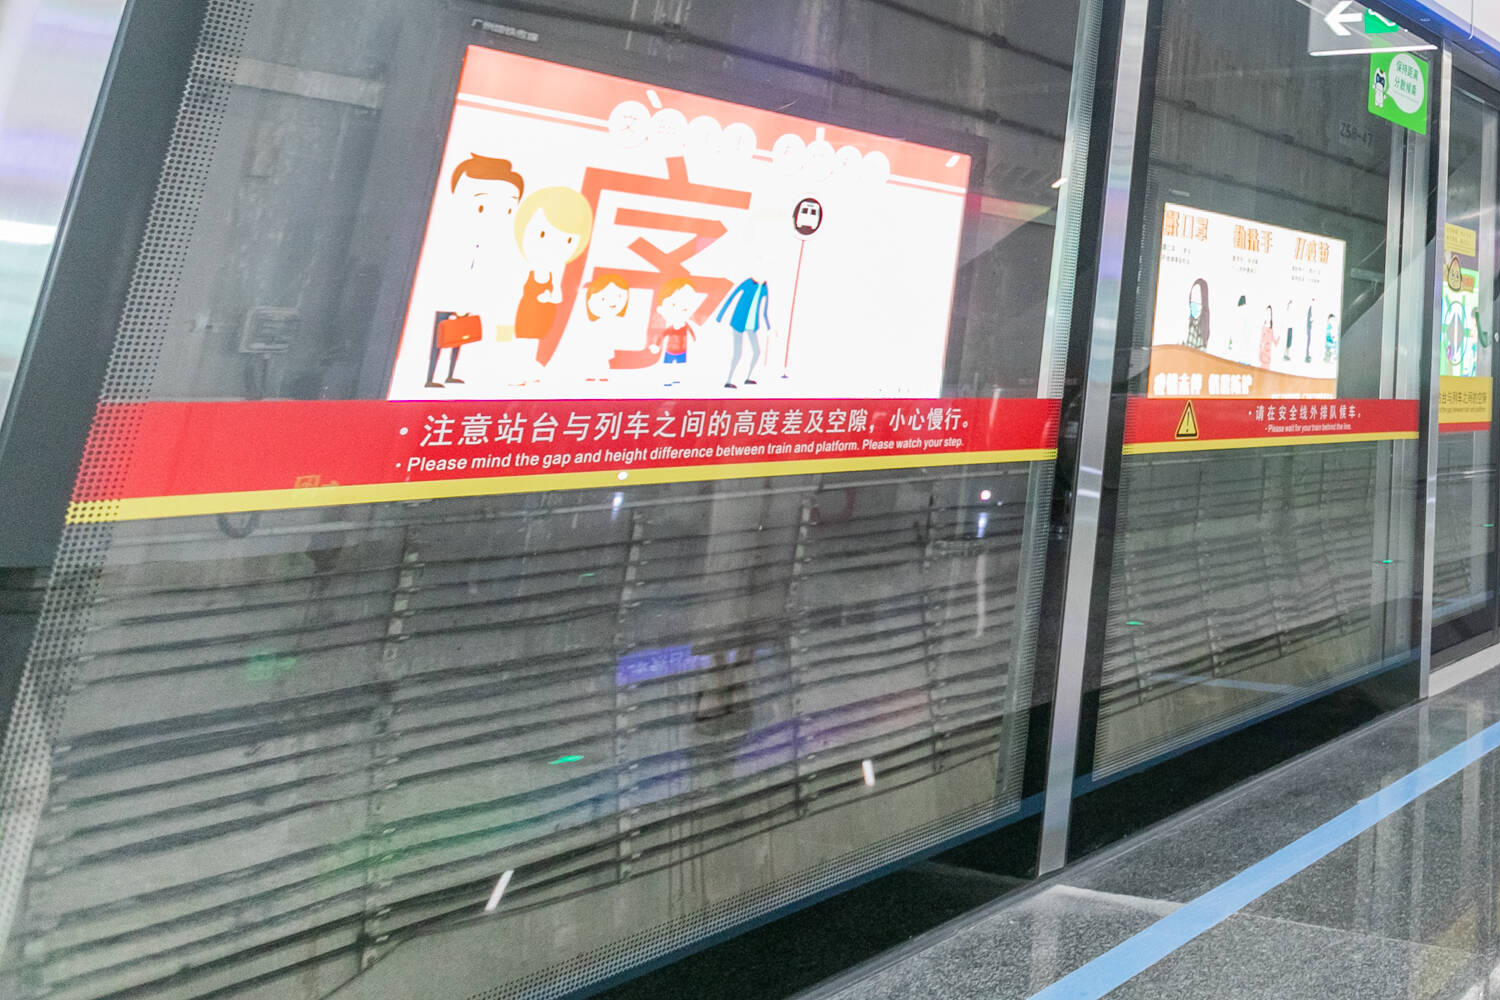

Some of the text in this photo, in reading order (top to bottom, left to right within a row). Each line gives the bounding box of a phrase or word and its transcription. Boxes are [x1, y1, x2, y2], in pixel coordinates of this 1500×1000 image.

[1255, 404, 1361, 422] 请在安全线外排队候车。
[420, 407, 969, 447] 注意站台与列车之间的高度差及空隙，小心慢行。
[1268, 424, 1285, 433] Please
[407, 437, 964, 472] Please mind the gap and height difference between train and platform. Please watch your step.
